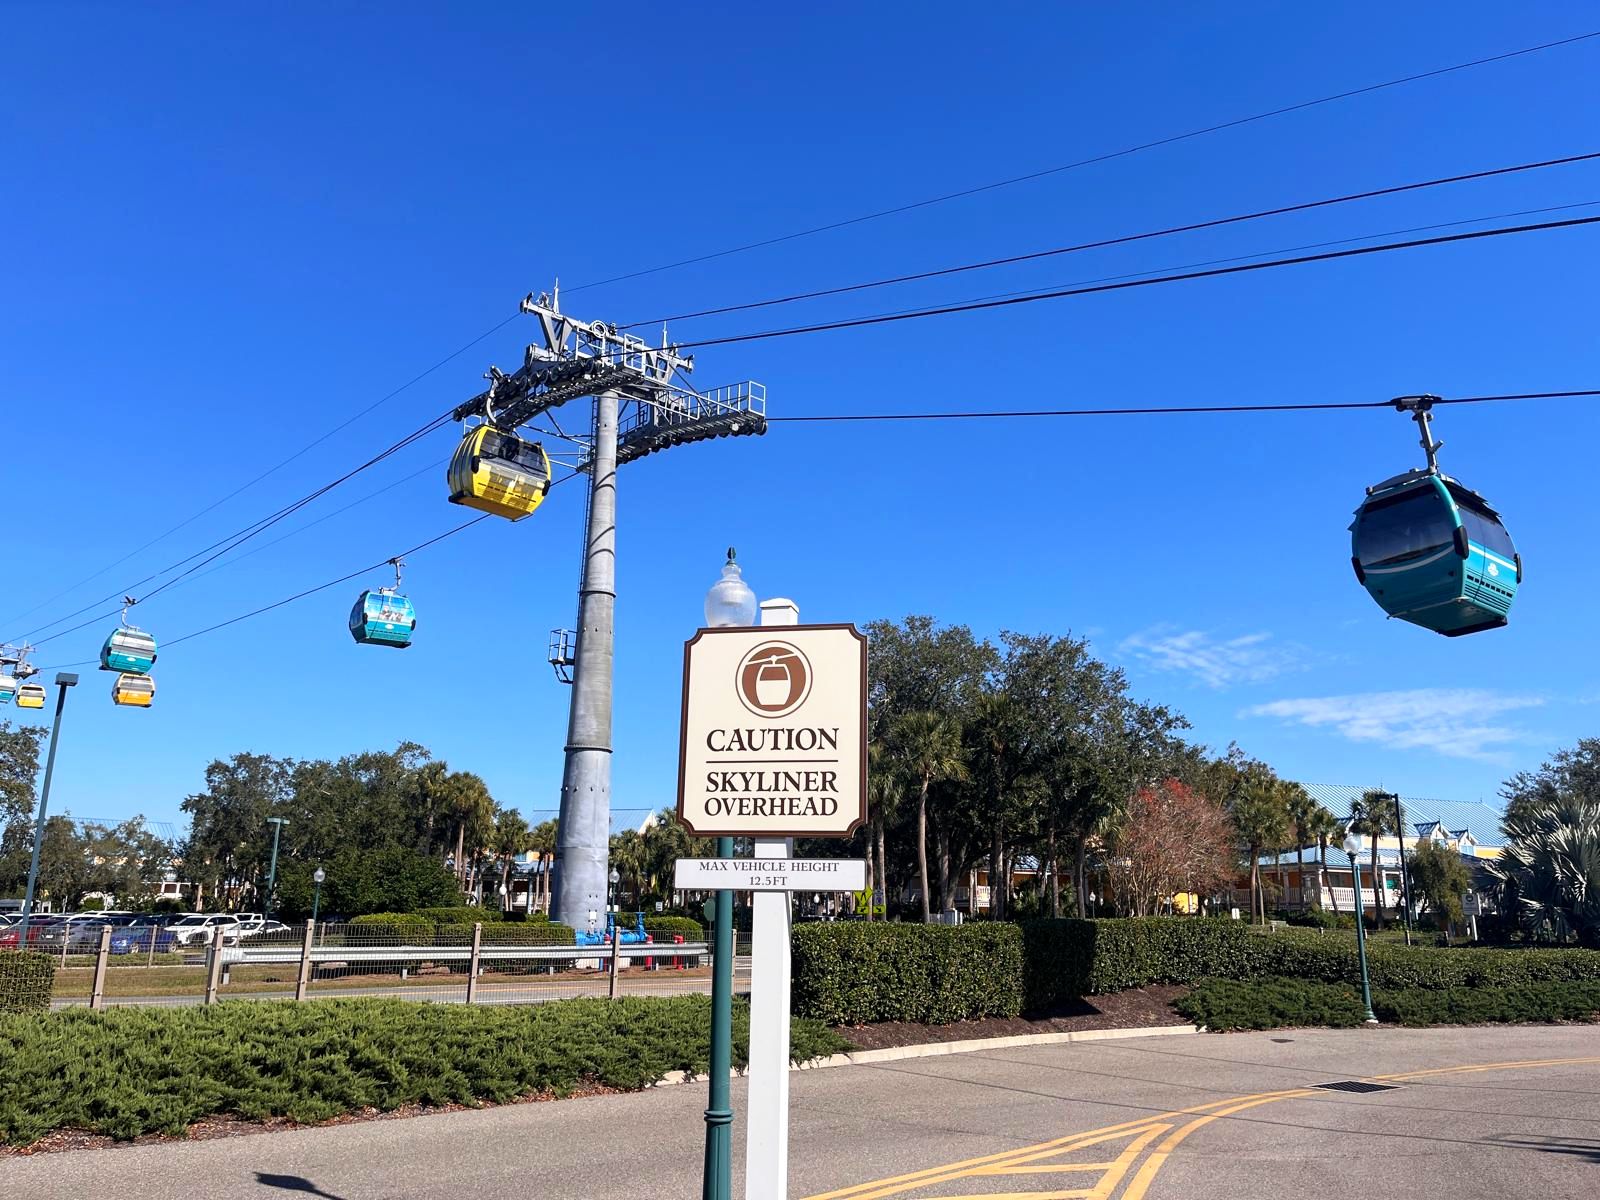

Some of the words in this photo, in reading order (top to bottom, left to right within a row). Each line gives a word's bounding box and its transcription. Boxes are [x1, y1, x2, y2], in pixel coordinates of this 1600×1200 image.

[706, 727, 839, 752] CAUTION
[705, 771, 839, 793] SKYLINER
[704, 797, 838, 817] OVERHEAD
[699, 861, 728, 871] MAX
[732, 861, 786, 872] VEHICLE
[791, 862, 840, 872] HEIGHT
